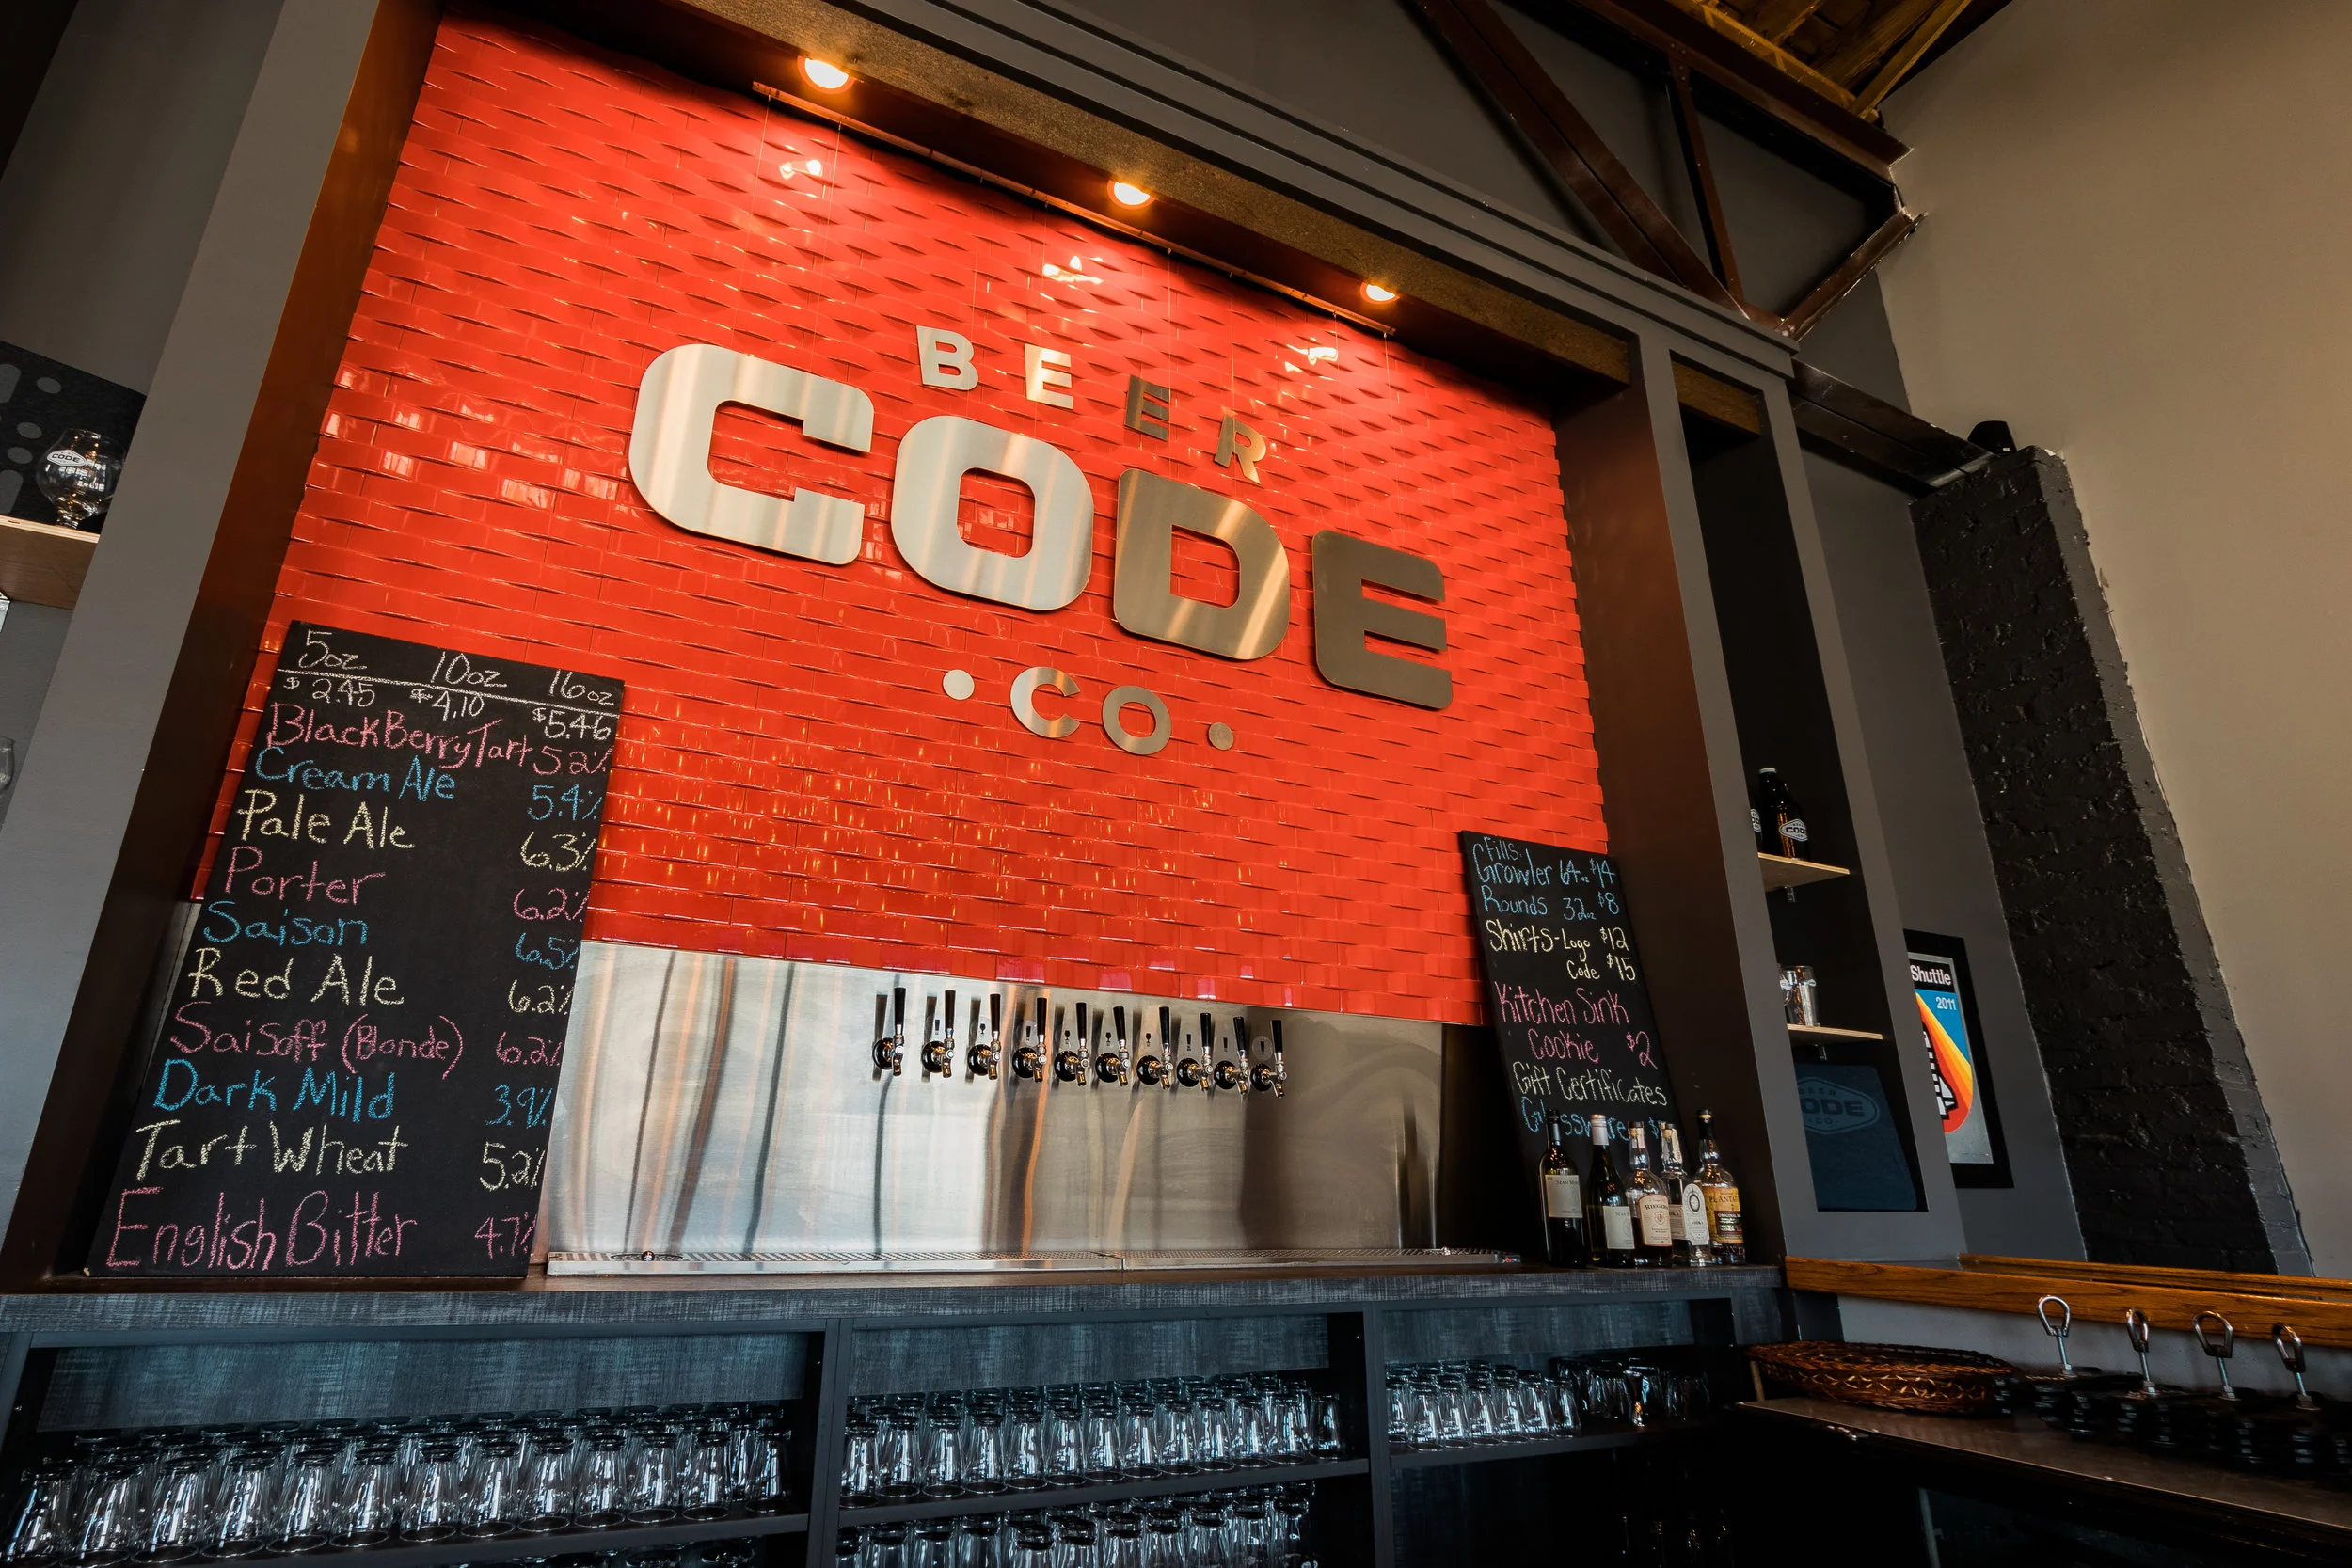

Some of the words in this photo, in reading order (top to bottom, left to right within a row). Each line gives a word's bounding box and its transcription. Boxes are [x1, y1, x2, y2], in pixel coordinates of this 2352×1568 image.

[916, 325, 1267, 484] BEER
[52, 453, 80, 463] CODE
[628, 343, 1454, 710] CODE
[297, 629, 368, 670] 5oz
[430, 651, 508, 688] 10oz
[548, 669, 615, 705] 16oz
[532, 707, 612, 740] $5.46
[255, 746, 390, 792] Cream
[399, 755, 455, 801] Ale
[527, 784, 603, 821] 5.4%
[237, 789, 331, 843] Pale
[343, 800, 416, 849] Ale
[520, 832, 597, 872] 6.3%
[225, 846, 386, 904] Porter
[513, 887, 591, 923] 6.2%
[1472, 843, 1552, 887] Growler
[1589, 858, 1616, 889] $14
[1481, 884, 1548, 916] Rounds
[1597, 891, 1620, 915] $8
[203, 900, 369, 946] Saison
[515, 932, 582, 970] 6.5%
[1600, 927, 1629, 952] $12
[187, 947, 294, 999] Red
[311, 953, 405, 1006] Ale
[508, 978, 575, 1016] 6.2%
[1566, 959, 1600, 980] Code
[1606, 953, 1636, 981] $15
[1911, 964, 1952, 986] Shuttle
[1494, 980, 1577, 1025] Kitchen
[1576, 987, 1630, 1025] Sink
[1935, 997, 1957, 1011] 2011
[495, 1031, 564, 1067] 6.2%
[1527, 1028, 1599, 1064] Cookie
[1626, 1030, 1658, 1069] $2
[153, 1058, 278, 1112] Dark
[293, 1067, 395, 1123] Mild
[485, 1084, 553, 1129] 3.9%
[1512, 1061, 1552, 1096] Gift
[1555, 1066, 1668, 1106] Certificates
[1799, 1097, 1867, 1117] ODE
[136, 1119, 258, 1181] Tart
[270, 1121, 409, 1175] Wheat
[479, 1140, 546, 1191] 5.2%
[105, 1186, 278, 1272] English
[286, 1190, 418, 1268] Bitter
[474, 1212, 538, 1259] 4.7%
